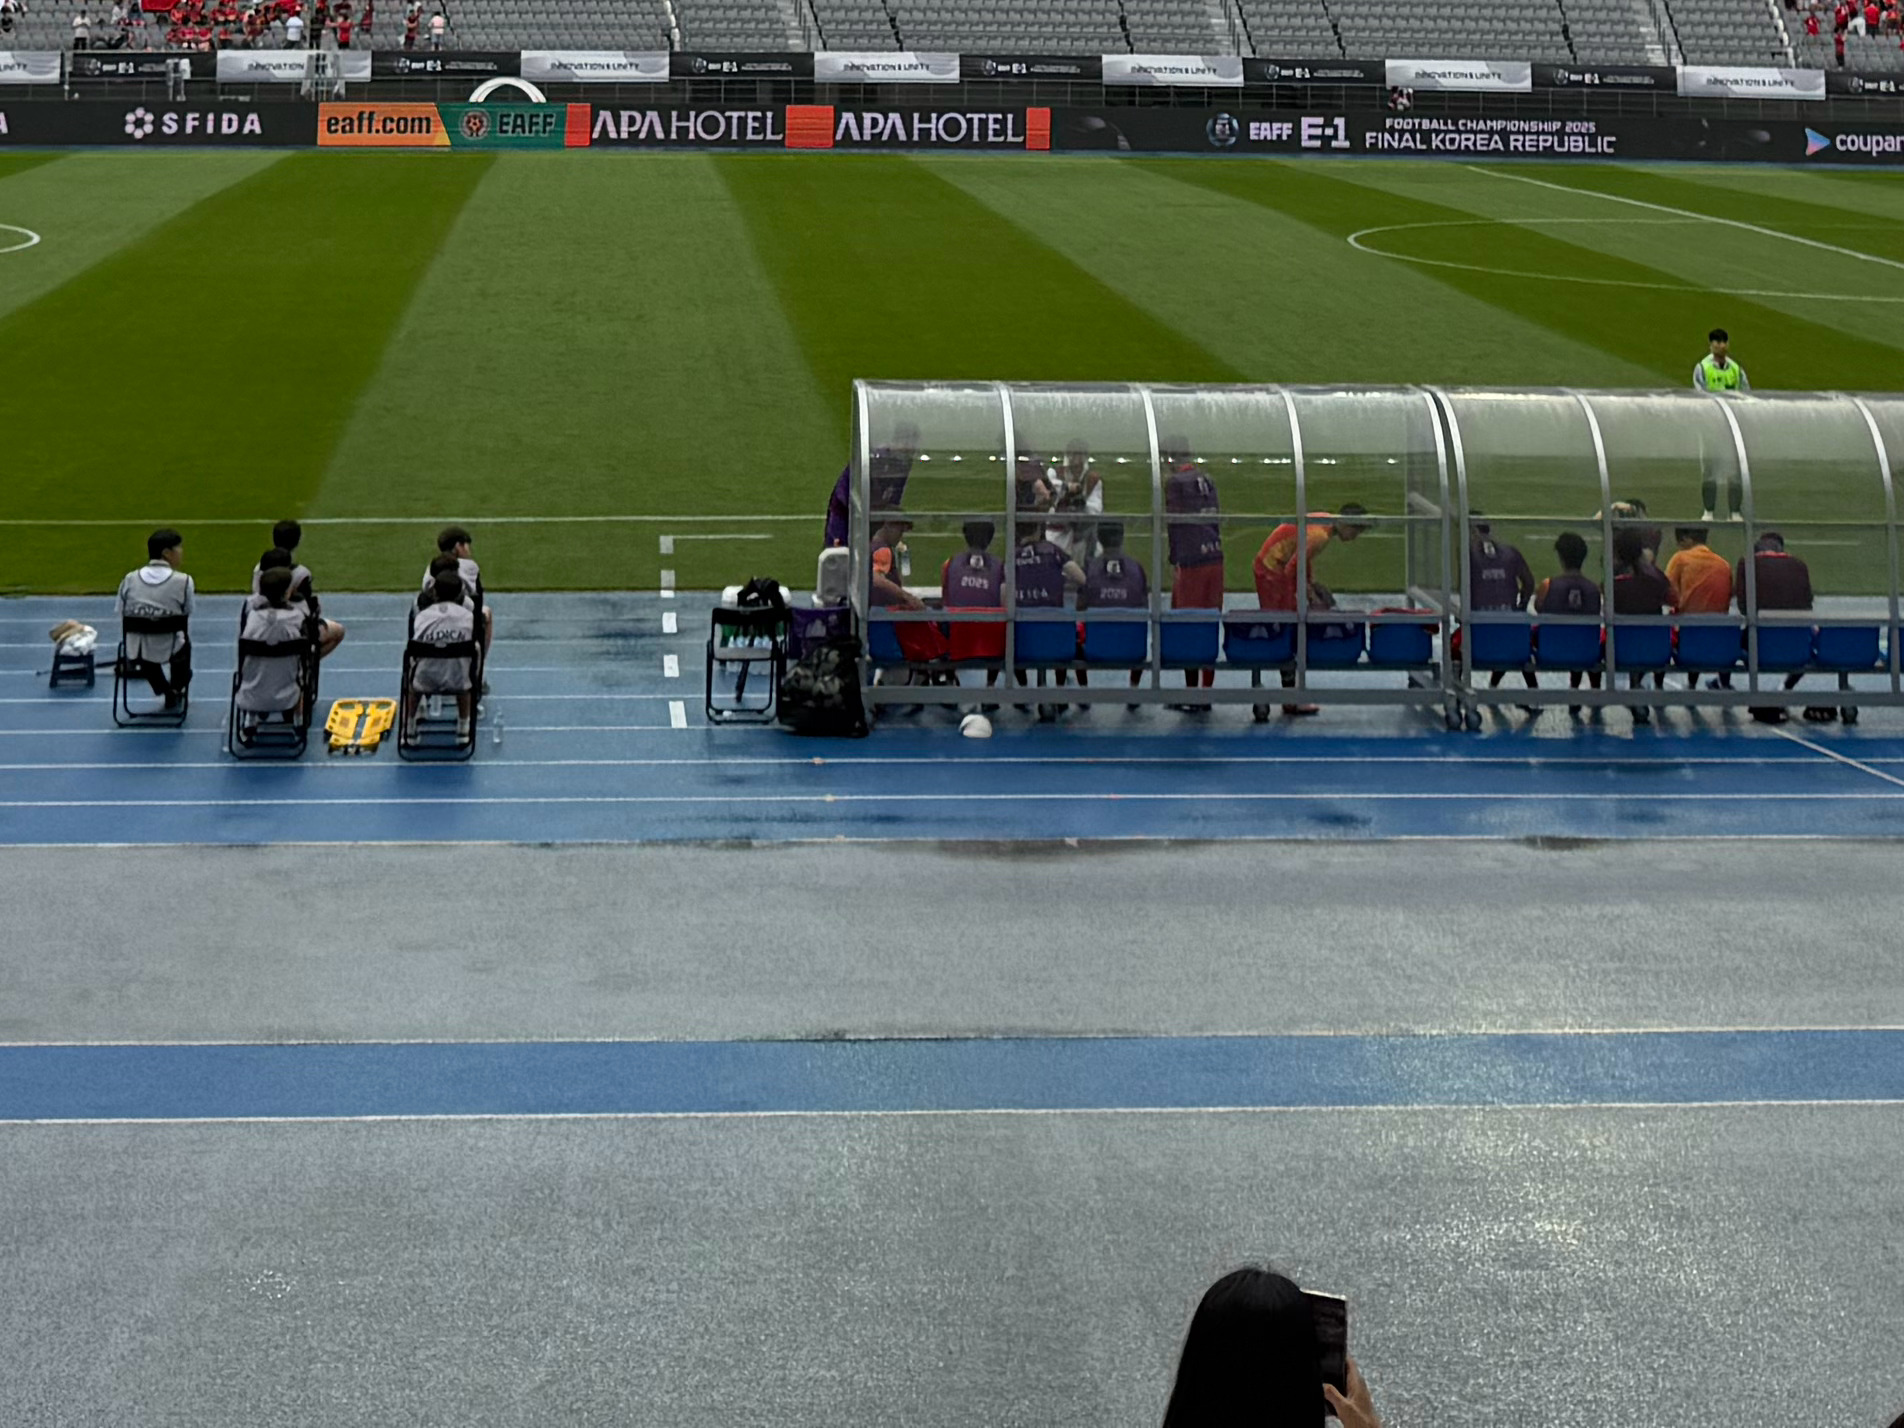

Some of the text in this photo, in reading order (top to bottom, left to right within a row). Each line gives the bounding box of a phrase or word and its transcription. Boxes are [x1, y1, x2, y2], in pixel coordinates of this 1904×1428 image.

[162, 113, 262, 135] SFIDA
[326, 111, 431, 136] eaff.com
[498, 112, 556, 137] EAFF
[592, 110, 783, 141] APA HOTEL
[835, 112, 1024, 143] APA HOTEL
[1249, 116, 1350, 148] EAFF E-1
[1385, 118, 1596, 133] FOOTBALL CHAMPIONSHIP 2025
[1365, 132, 1617, 153] FINAL KOREA REPUBLIC
